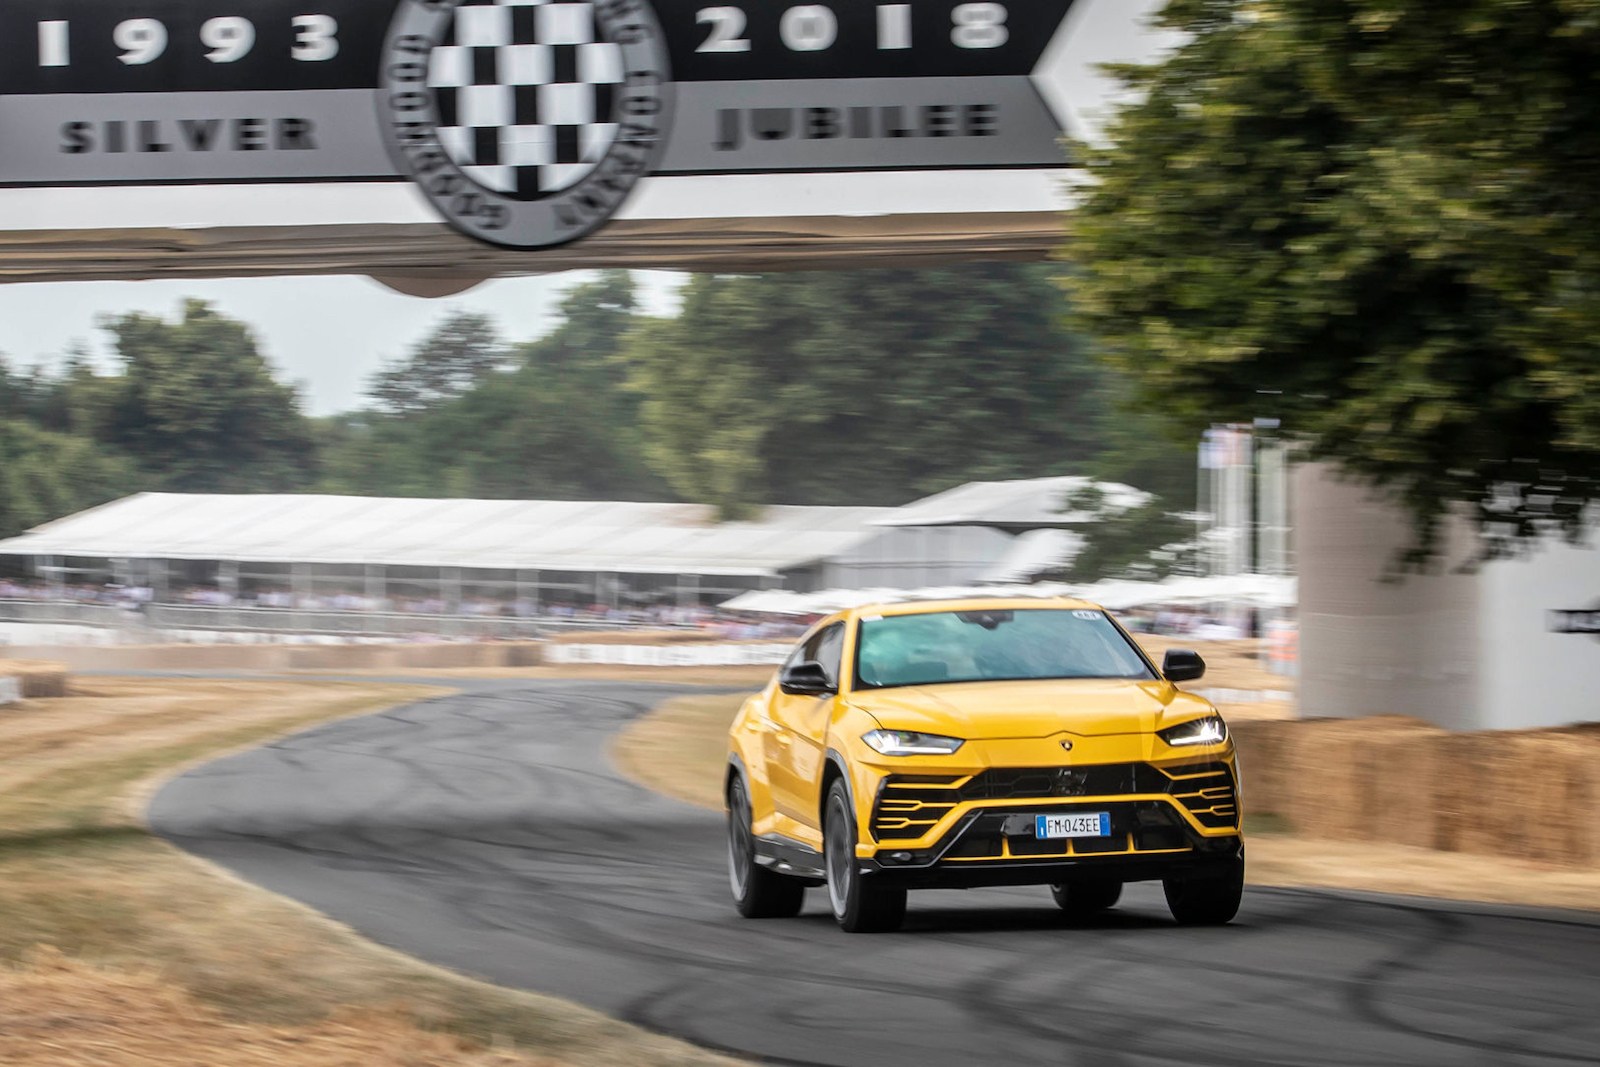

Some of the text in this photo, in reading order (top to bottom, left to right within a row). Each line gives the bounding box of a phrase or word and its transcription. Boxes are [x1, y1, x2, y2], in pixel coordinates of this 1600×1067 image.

[37, 14, 340, 67] 1993
[694, 2, 1009, 53] 2018
[58, 103, 1000, 155] SILVER JUBILEE
